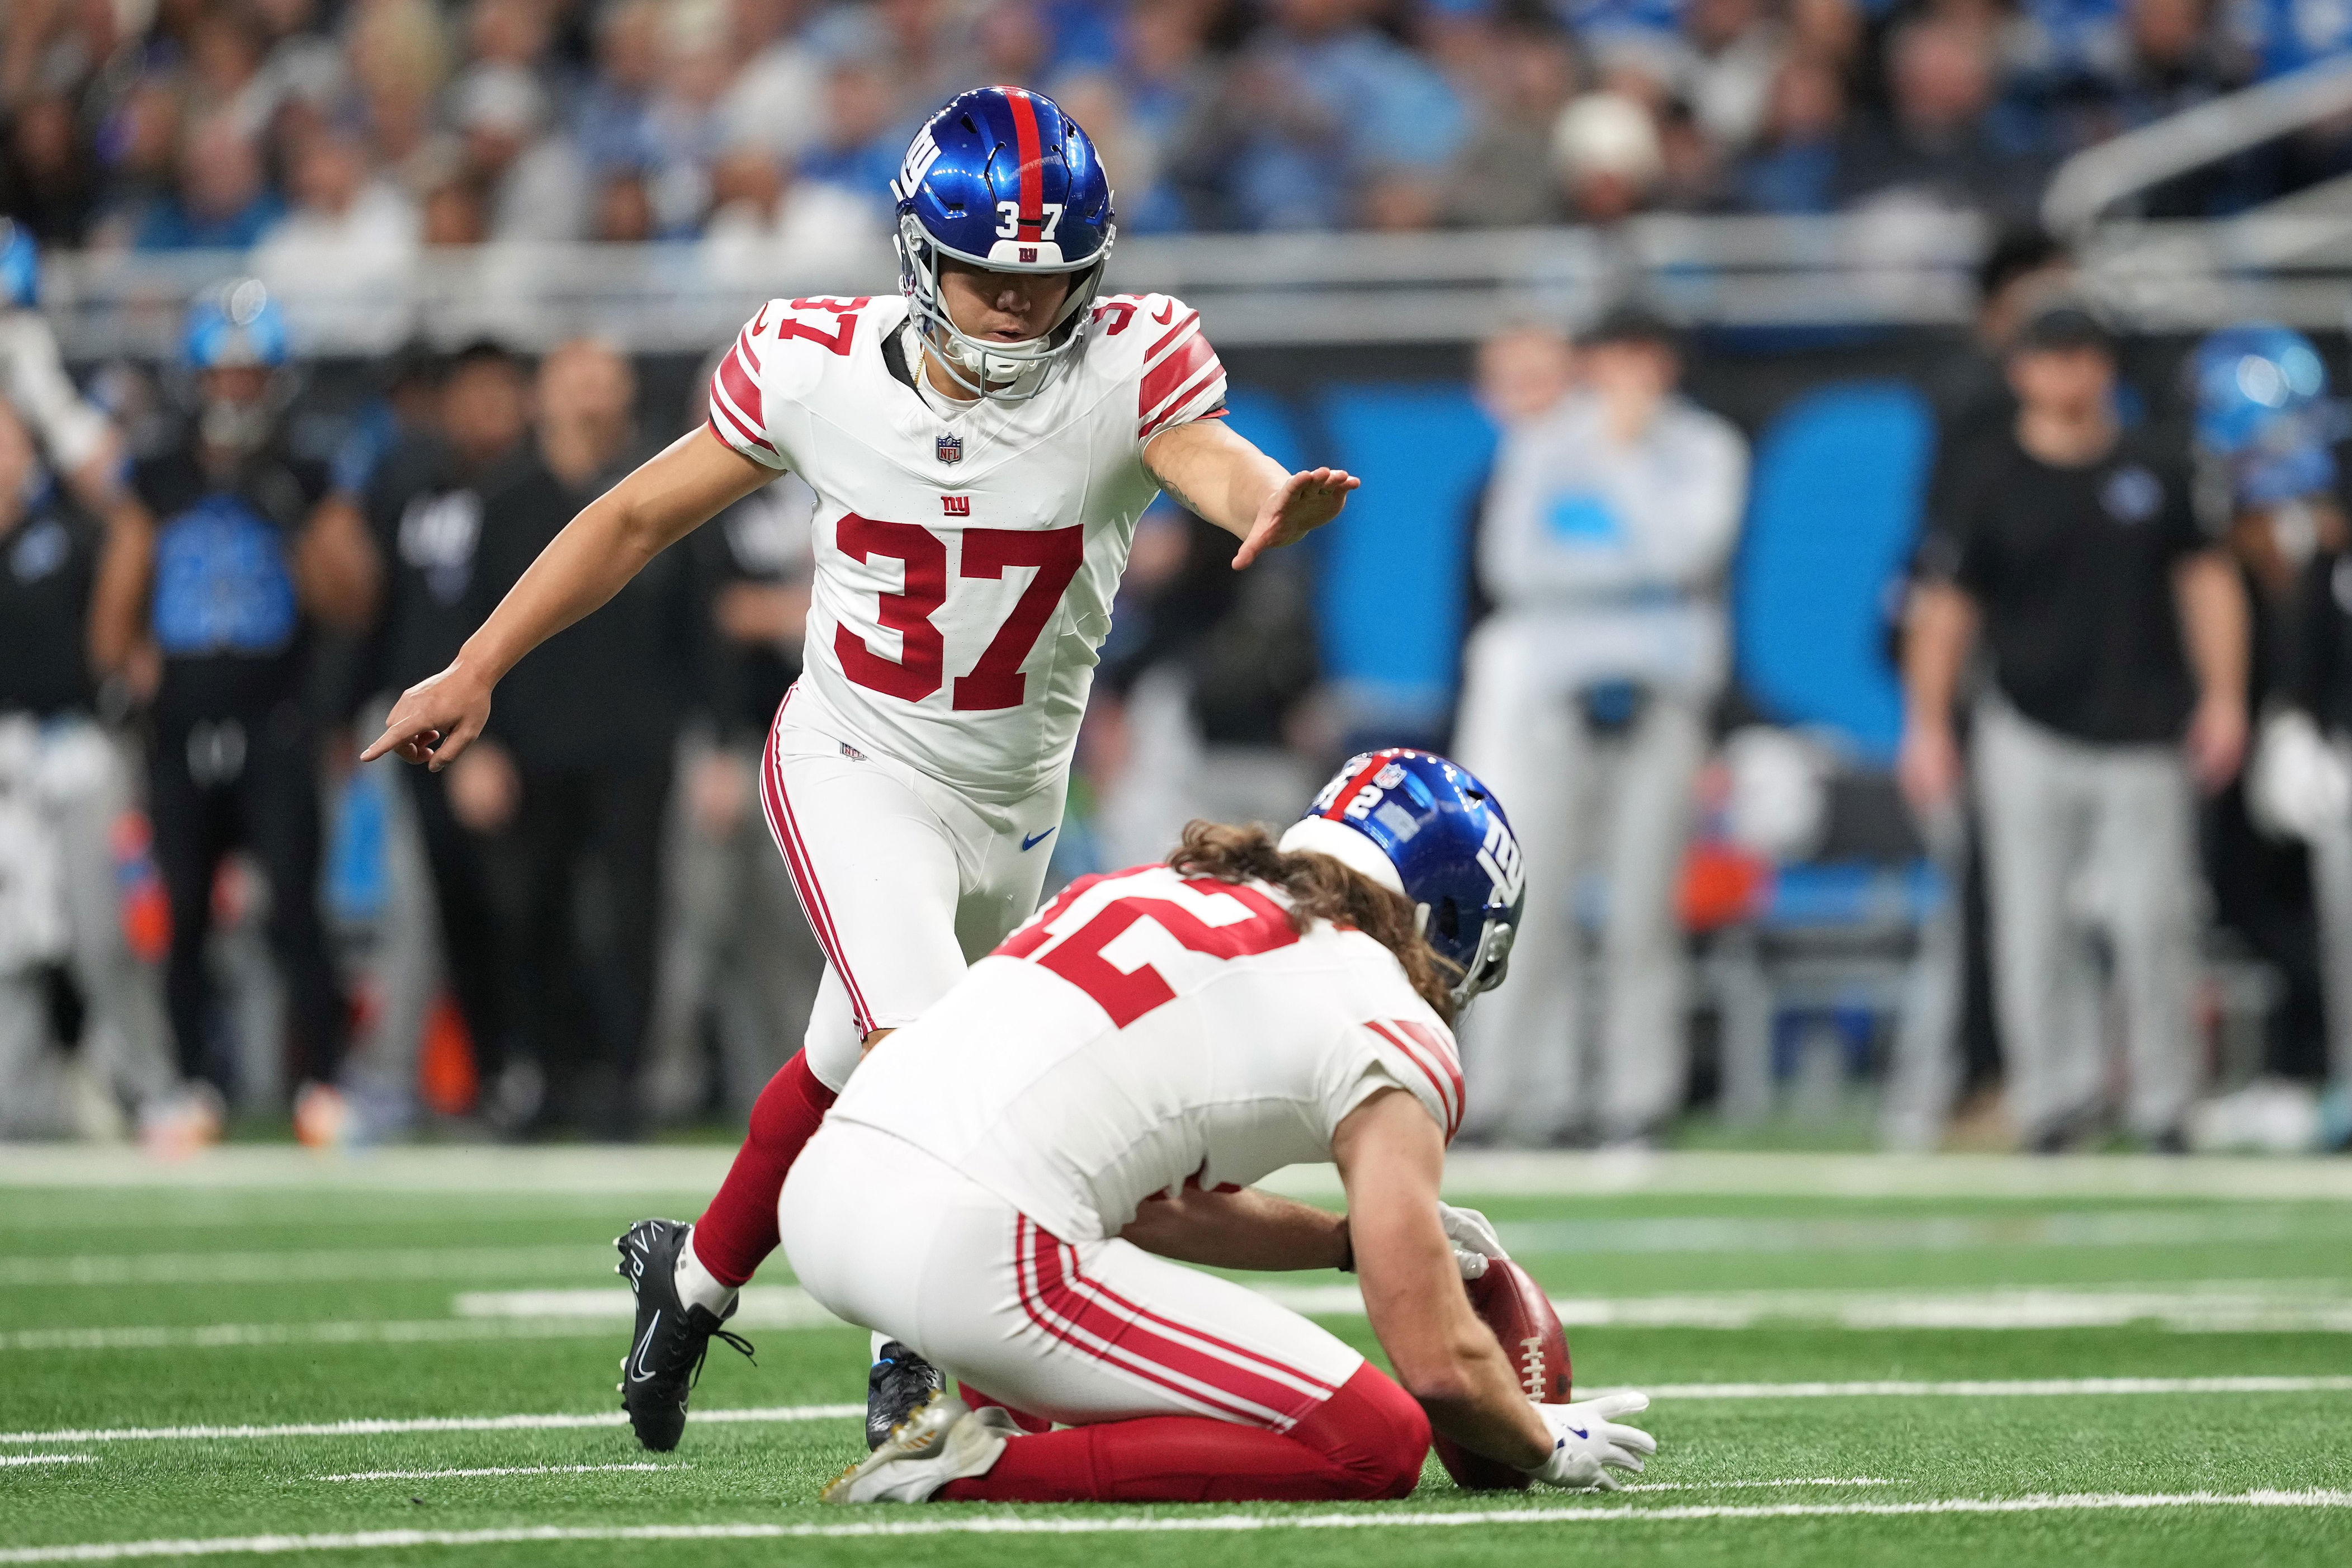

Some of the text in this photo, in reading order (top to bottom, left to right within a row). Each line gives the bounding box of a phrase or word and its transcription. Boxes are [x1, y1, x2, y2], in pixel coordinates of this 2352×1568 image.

[995, 201, 1062, 240] 37
[939, 448, 959, 461] NFL
[833, 512, 1084, 711] 37
